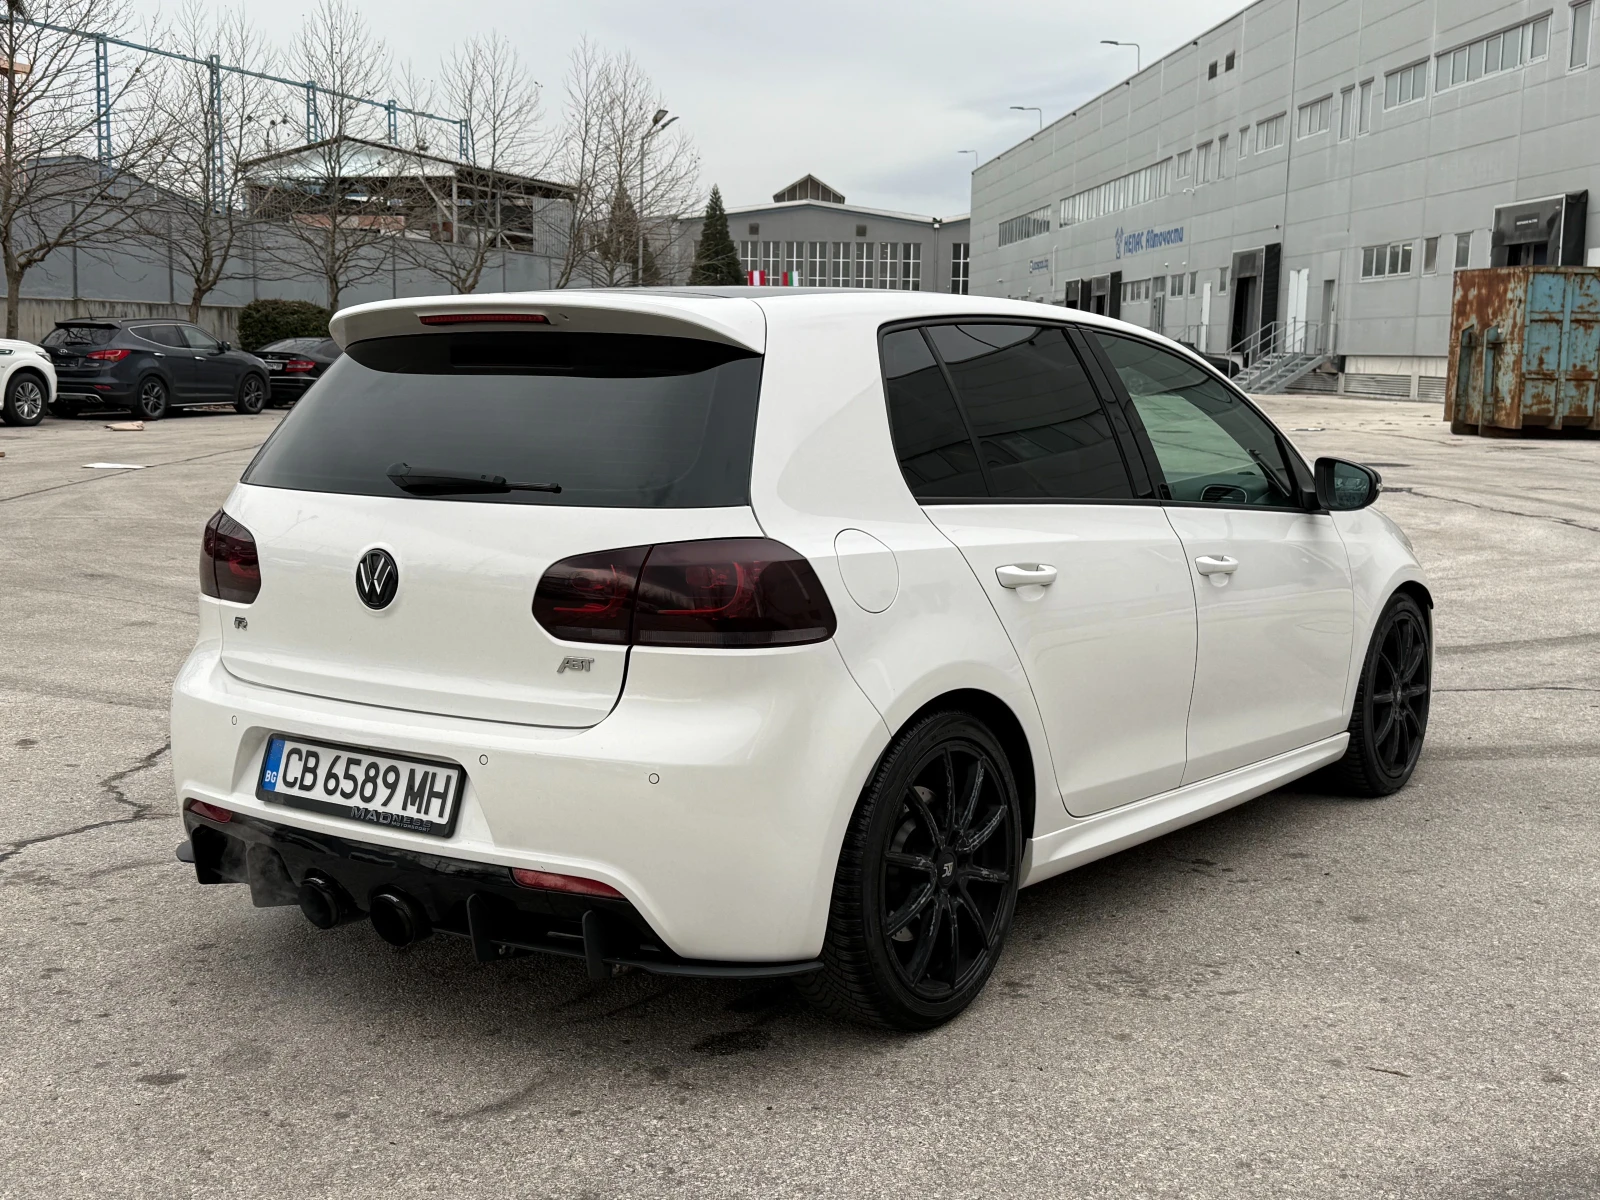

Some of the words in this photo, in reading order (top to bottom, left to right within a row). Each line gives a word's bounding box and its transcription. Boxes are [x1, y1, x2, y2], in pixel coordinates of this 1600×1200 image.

[234, 616, 248, 631] R
[556, 656, 595, 674] ABT
[264, 769, 278, 783] BG
[282, 747, 320, 792] CB
[323, 755, 401, 807] 6589
[402, 768, 452, 818] MH
[350, 806, 432, 828] MADNESS
[391, 821, 431, 833] MOTORSPORT
